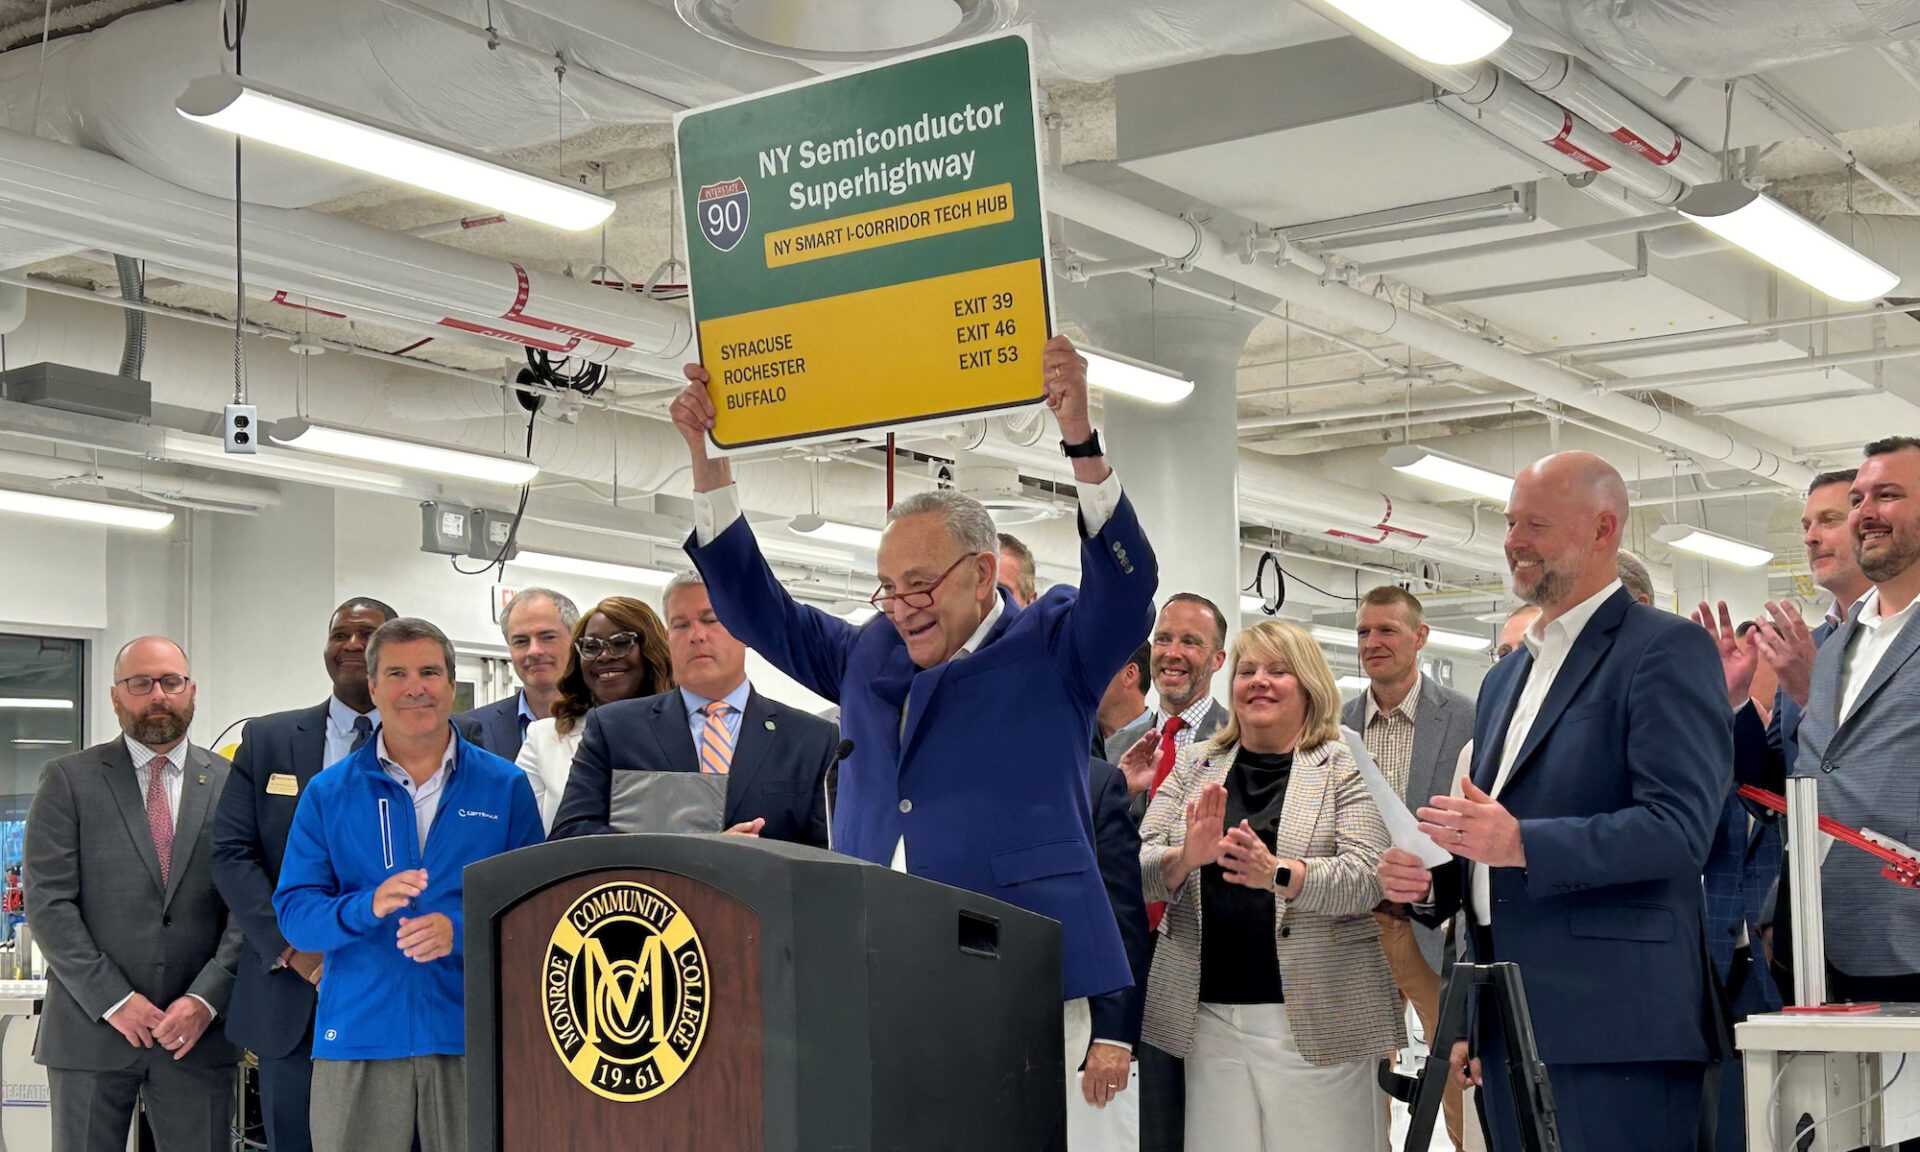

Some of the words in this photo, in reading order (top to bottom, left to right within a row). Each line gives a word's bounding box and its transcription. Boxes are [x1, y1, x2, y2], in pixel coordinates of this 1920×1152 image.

[758, 145, 792, 178] NY
[799, 102, 1004, 169] Semiconductor
[789, 150, 976, 210] Superhighway
[707, 200, 741, 236] 90
[774, 239, 792, 256] NY
[795, 228, 842, 252] SMART
[847, 211, 930, 241] I-CORRIDOR
[934, 201, 972, 224] TECH
[976, 194, 1008, 216] HUB
[954, 296, 988, 317] EXIT
[992, 292, 1013, 310] 39
[721, 333, 793, 360] SYRACUSE
[957, 323, 990, 344] EXIT
[994, 319, 1016, 337] 46
[724, 358, 806, 385] ROCHESTER
[959, 349, 992, 370] EXIT
[997, 345, 1018, 364] 53
[727, 386, 787, 410] BUFFALO
[573, 889, 674, 931] COMMUNITY
[550, 956, 580, 1051] MONROE
[673, 950, 702, 1051] COLLEGE
